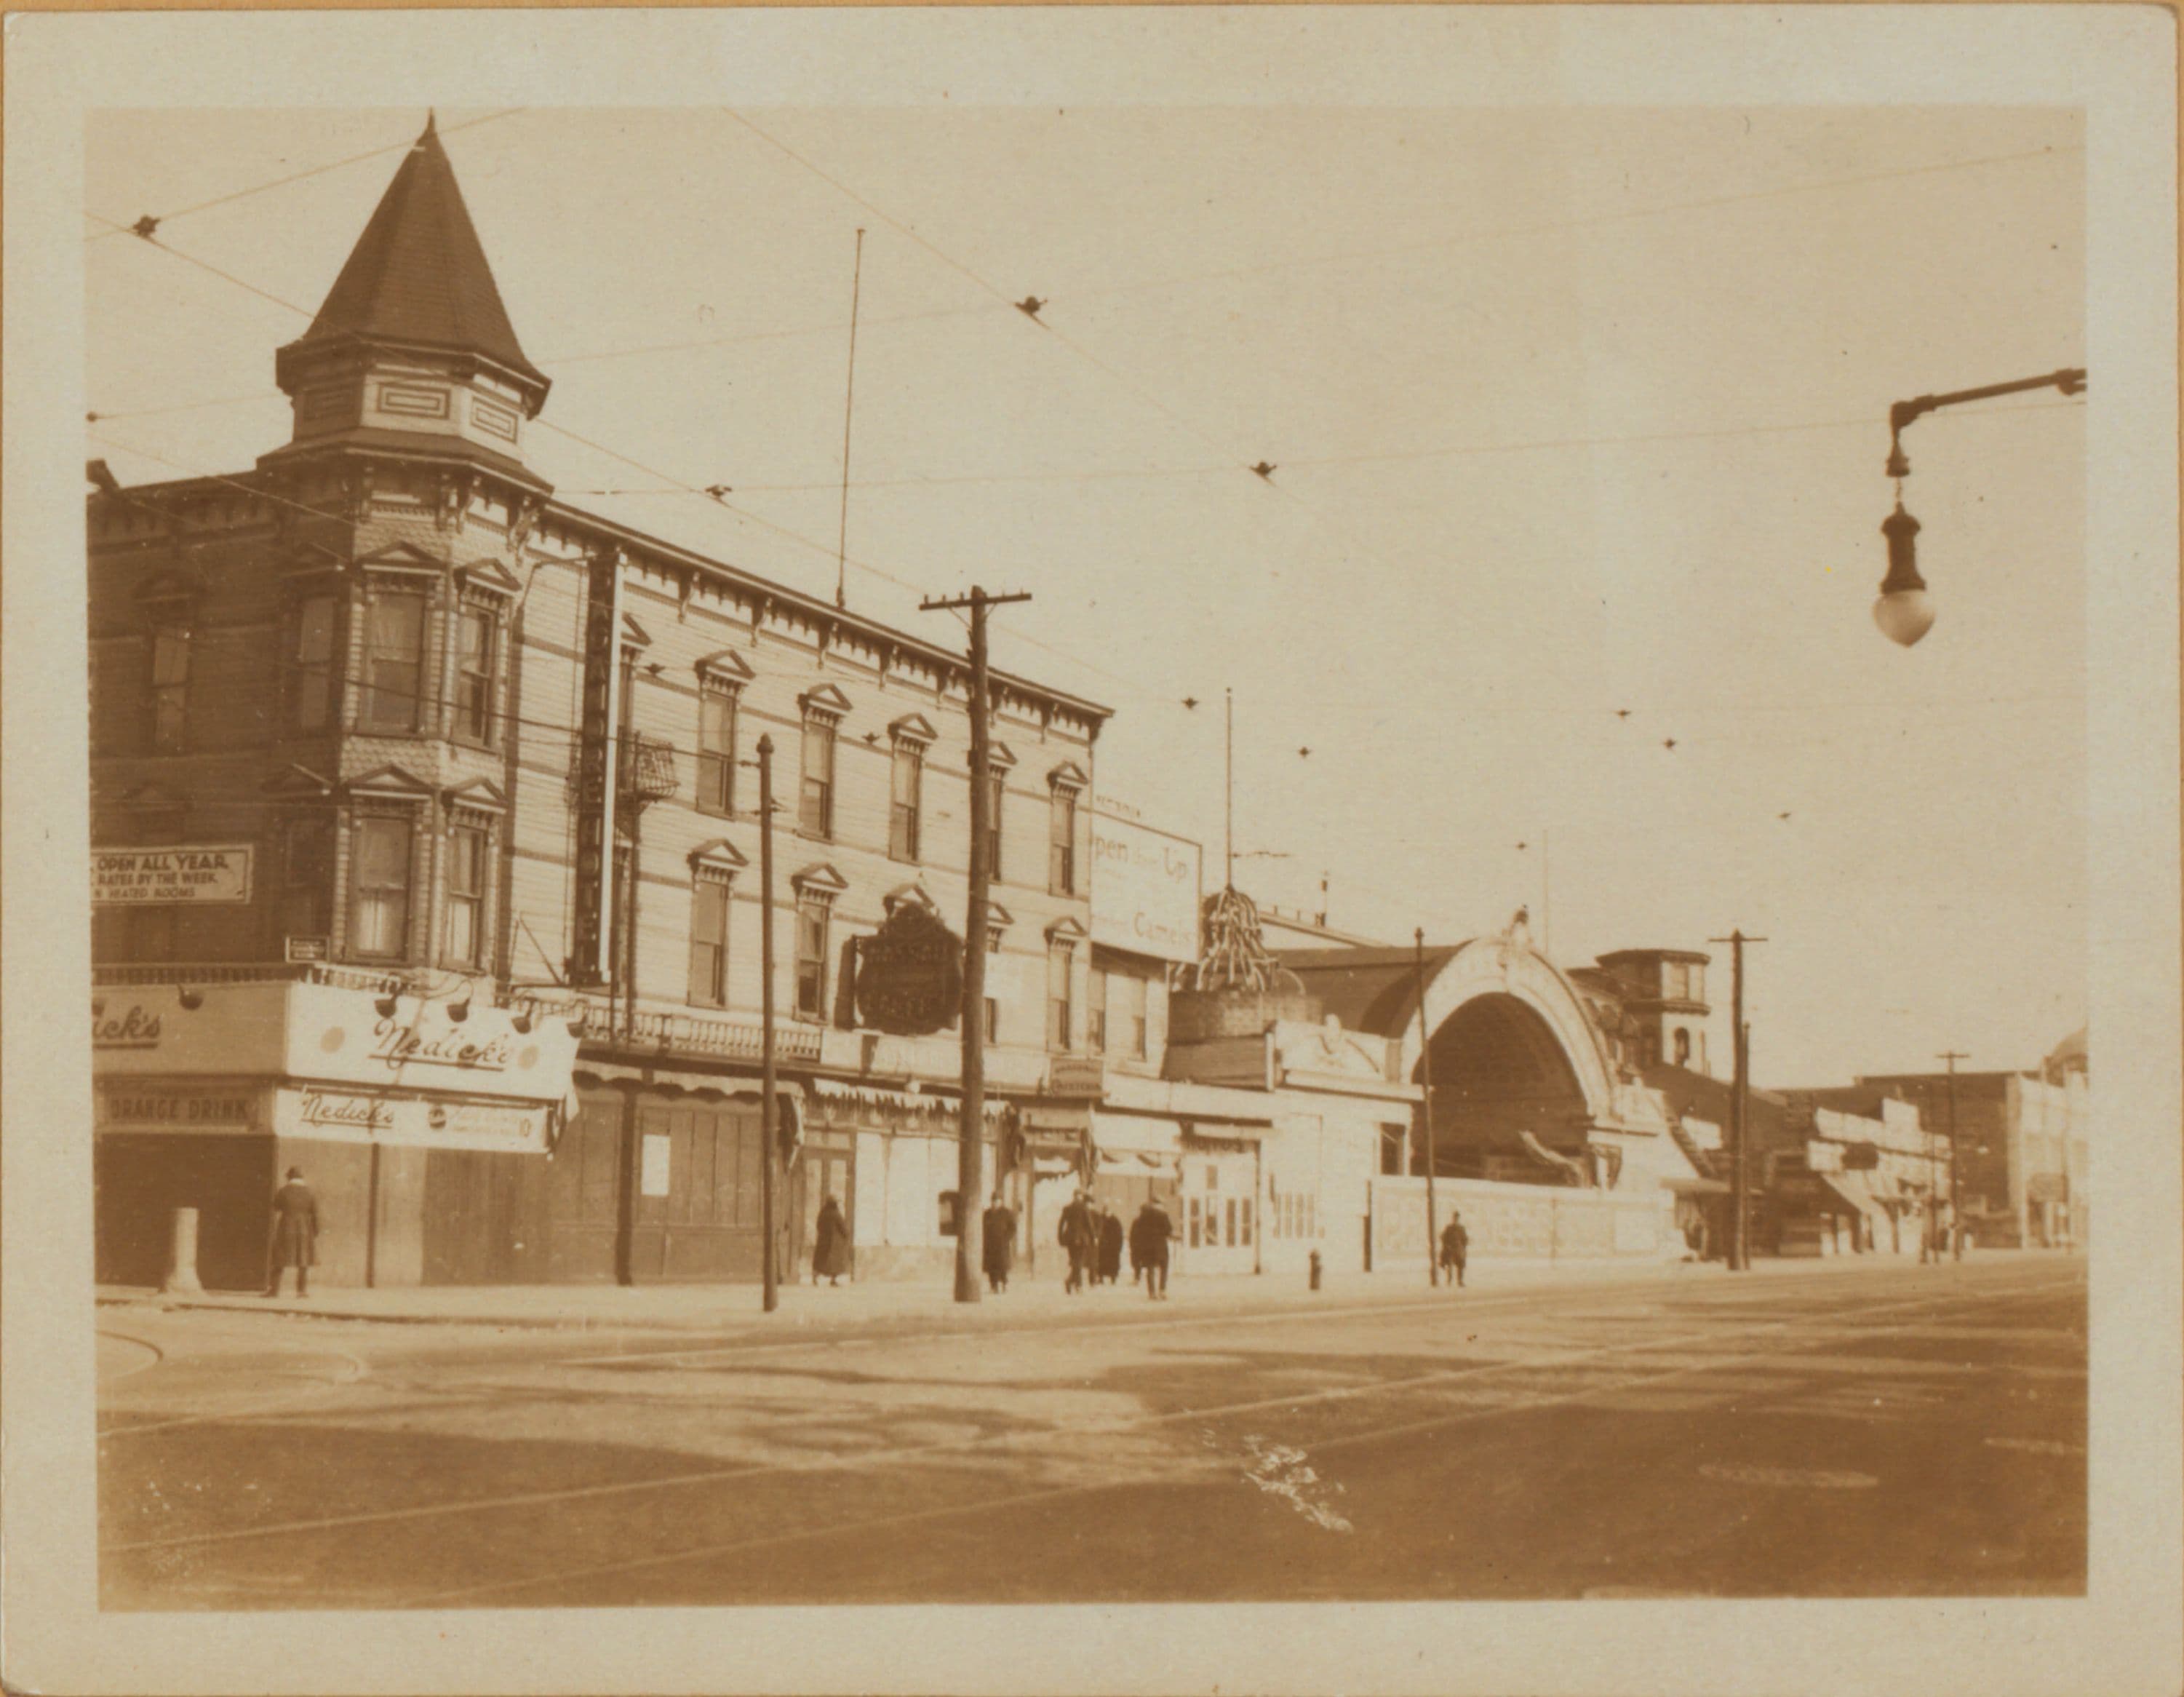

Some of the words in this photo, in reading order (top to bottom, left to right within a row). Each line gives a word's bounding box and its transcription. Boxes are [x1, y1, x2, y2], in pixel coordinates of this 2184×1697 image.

[97, 855, 136, 871] OPEN
[141, 855, 170, 870] ALL
[175, 854, 228, 870] YEAR
[137, 873, 151, 885] BY
[156, 873, 178, 885] THE
[181, 873, 219, 885] WEEK
[154, 887, 196, 898] ROOMS
[188, 1099, 249, 1119] DRINK
